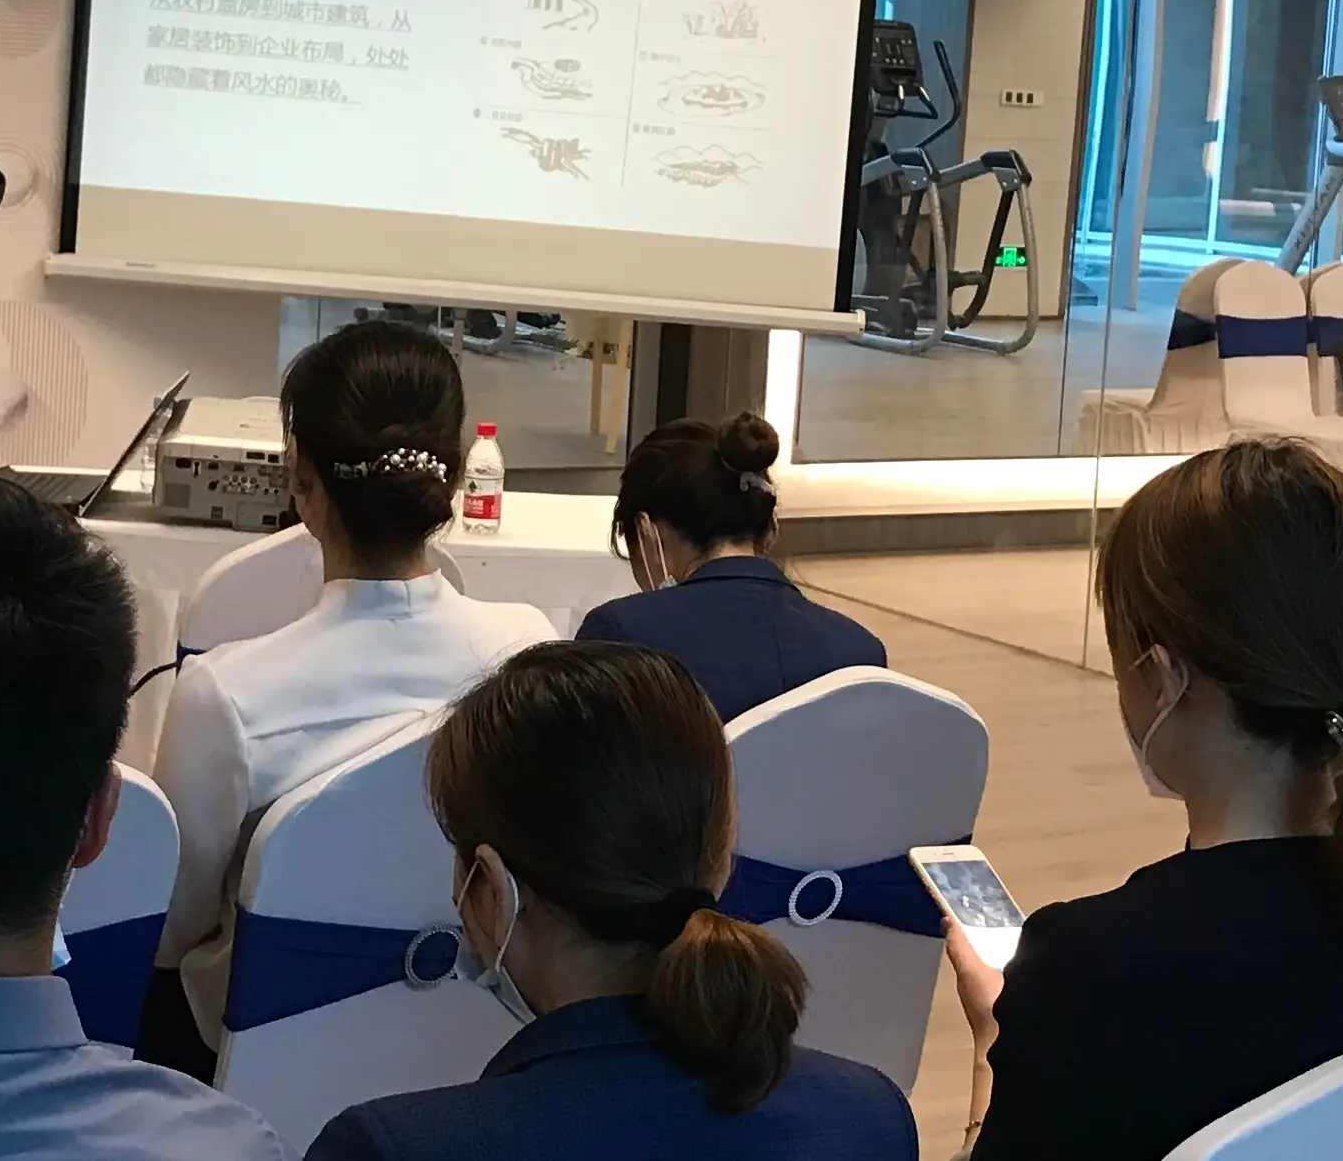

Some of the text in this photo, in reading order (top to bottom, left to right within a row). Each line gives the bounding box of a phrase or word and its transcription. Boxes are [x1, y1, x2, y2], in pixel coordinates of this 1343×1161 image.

[146, 24, 410, 69] 家居装饰到企业布局，处处
